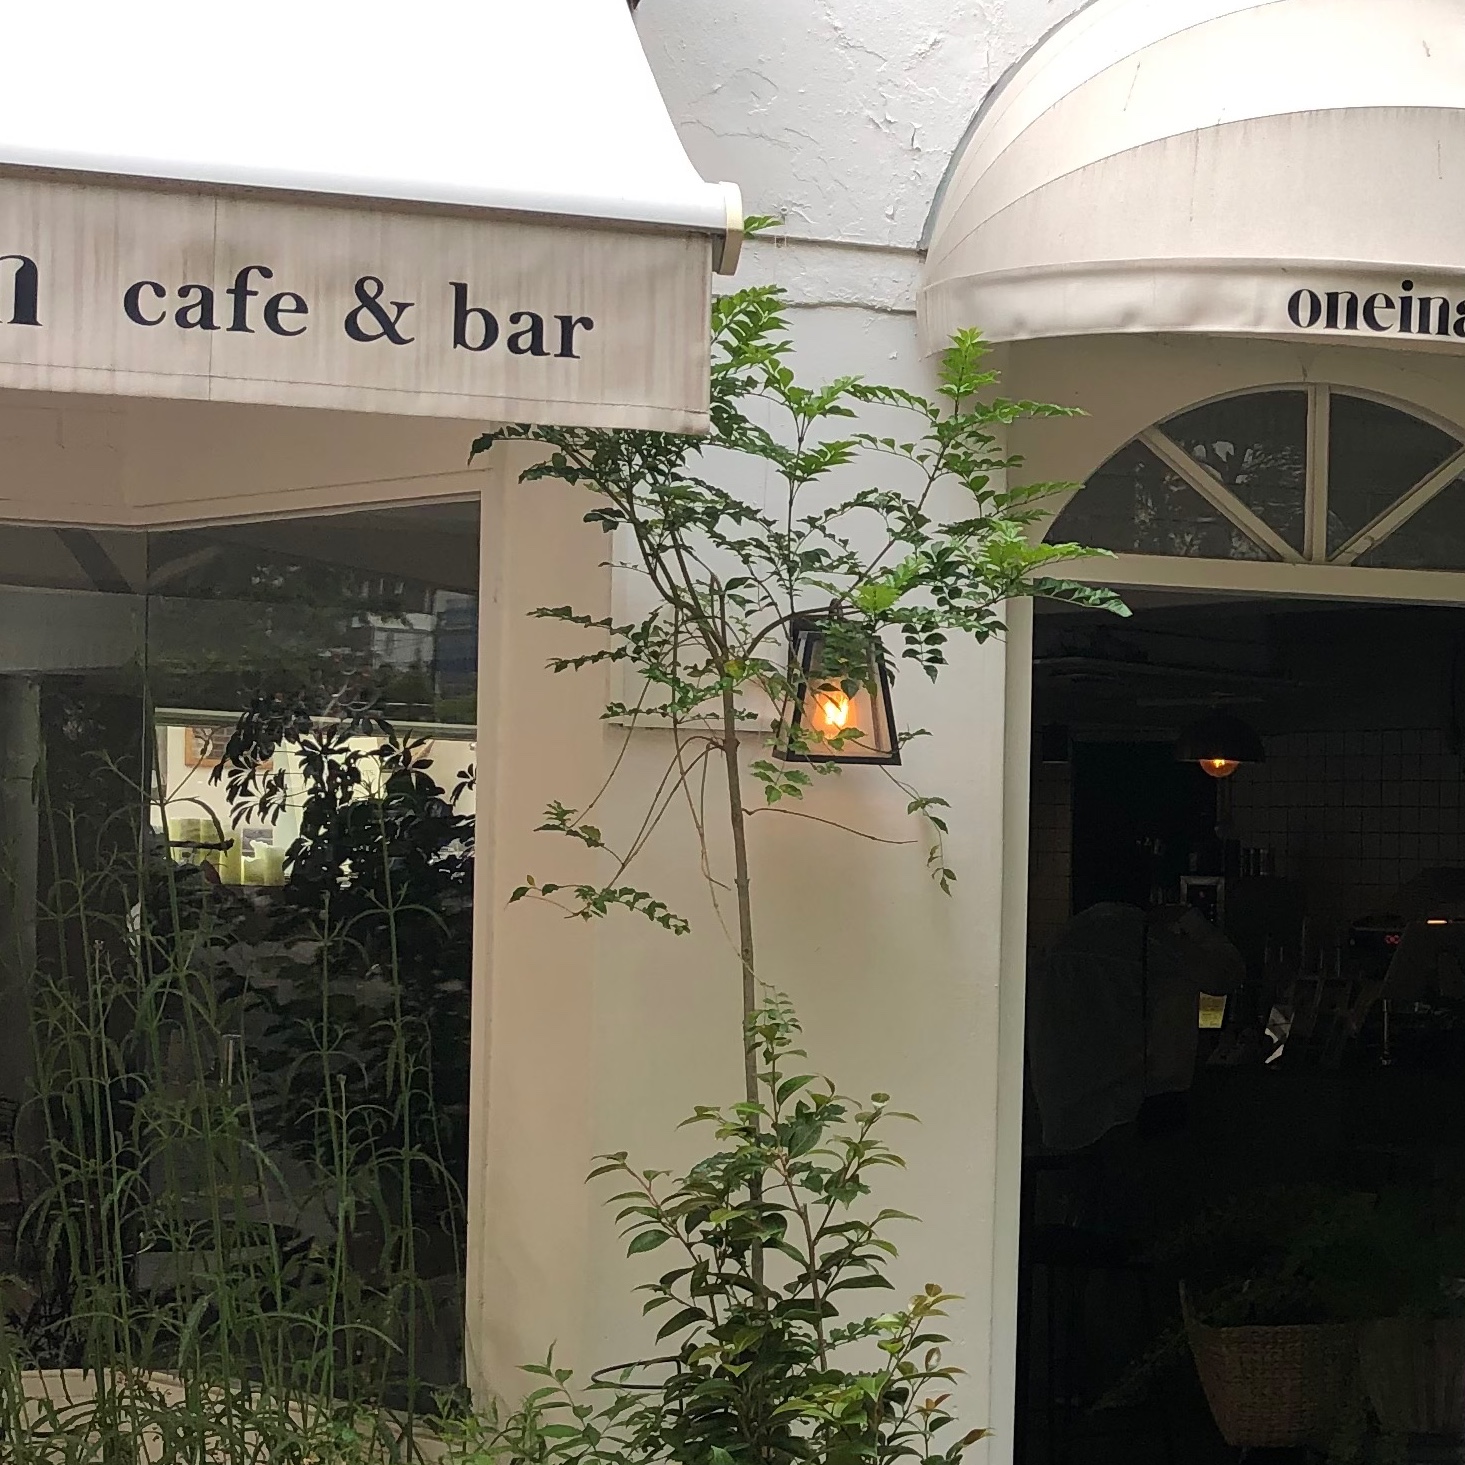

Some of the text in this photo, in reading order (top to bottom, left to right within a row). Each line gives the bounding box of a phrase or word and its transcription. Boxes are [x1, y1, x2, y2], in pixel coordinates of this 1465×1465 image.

[123, 265, 309, 337] cafe
[344, 275, 415, 346] &
[448, 281, 595, 359] bar
